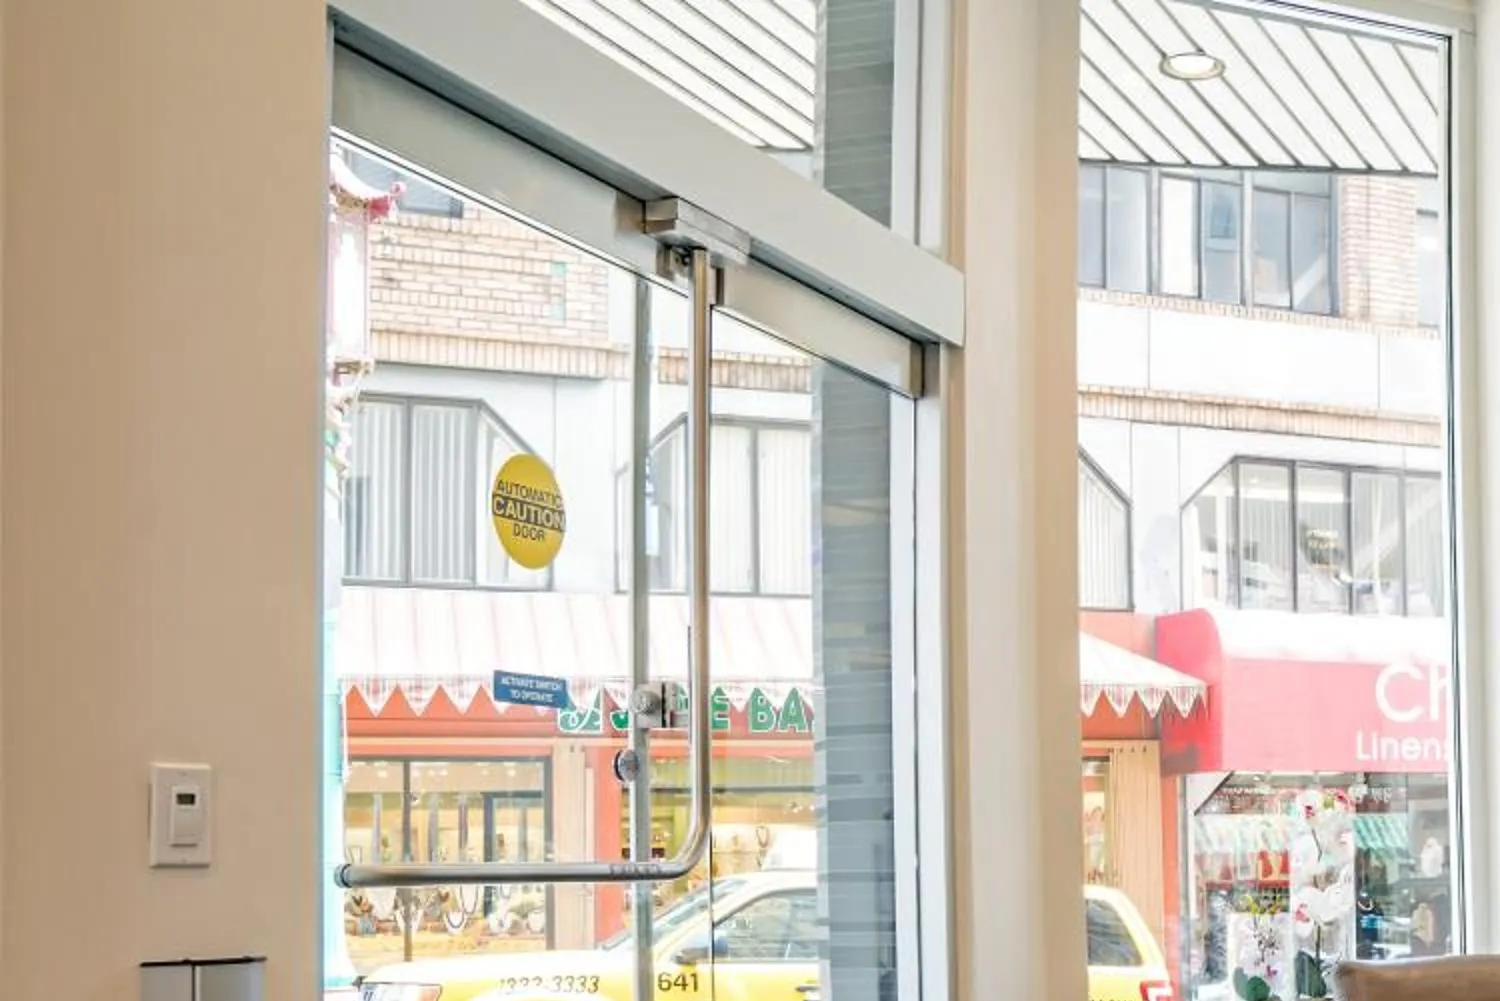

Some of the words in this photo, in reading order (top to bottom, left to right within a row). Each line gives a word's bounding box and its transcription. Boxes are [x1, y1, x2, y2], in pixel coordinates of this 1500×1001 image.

[496, 479, 564, 509] AUTOMATIC
[493, 494, 567, 532] CAUTION
[512, 522, 546, 541] DOOR
[748, 685, 815, 733] BA
[657, 971, 700, 993] 641
